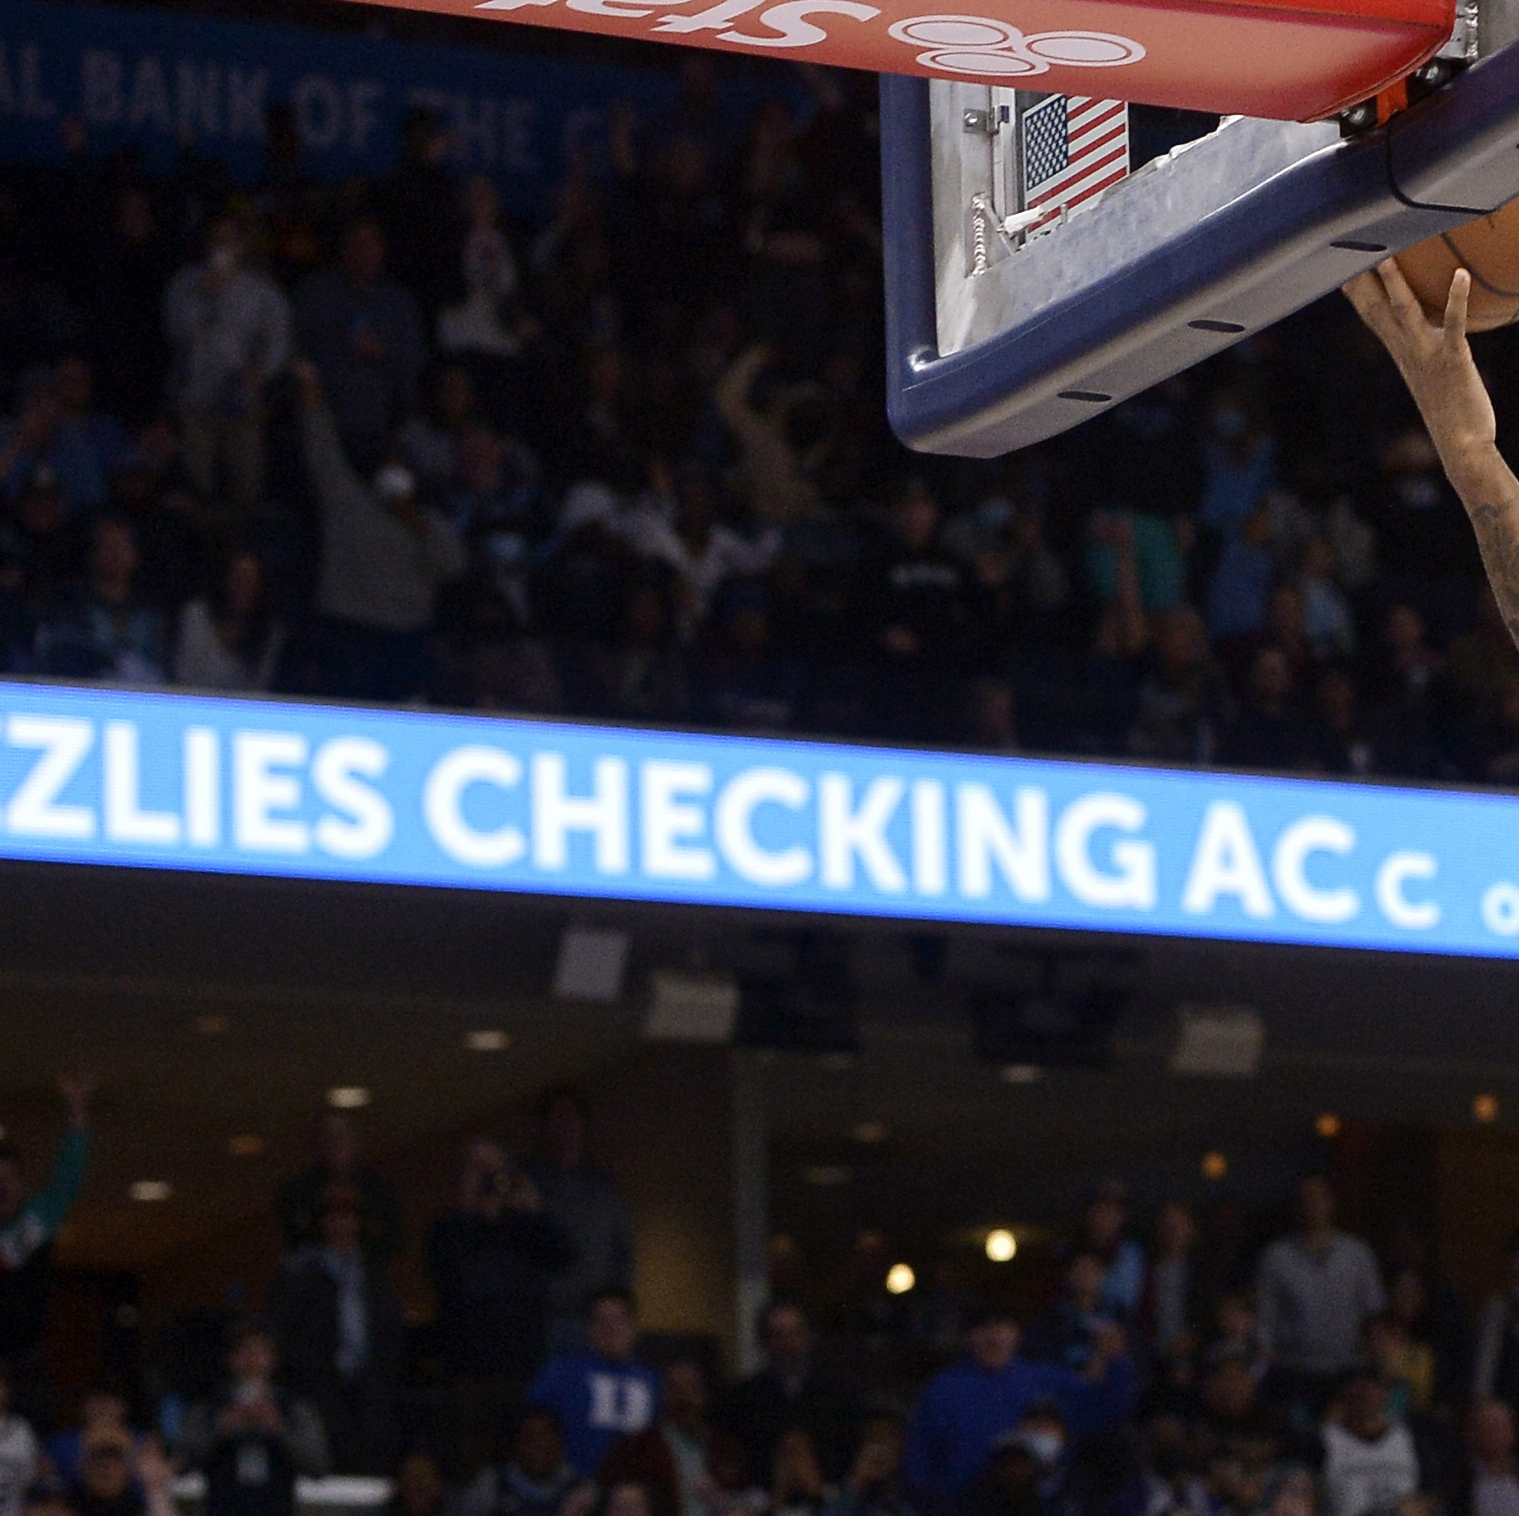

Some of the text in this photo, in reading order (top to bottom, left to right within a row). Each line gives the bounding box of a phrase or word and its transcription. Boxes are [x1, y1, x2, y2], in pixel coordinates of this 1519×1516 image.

[81, 49, 269, 142] BANK
[295, 73, 386, 152] OF
[4, 713, 396, 862] ZLIES
[423, 743, 1158, 910] CHECKING
